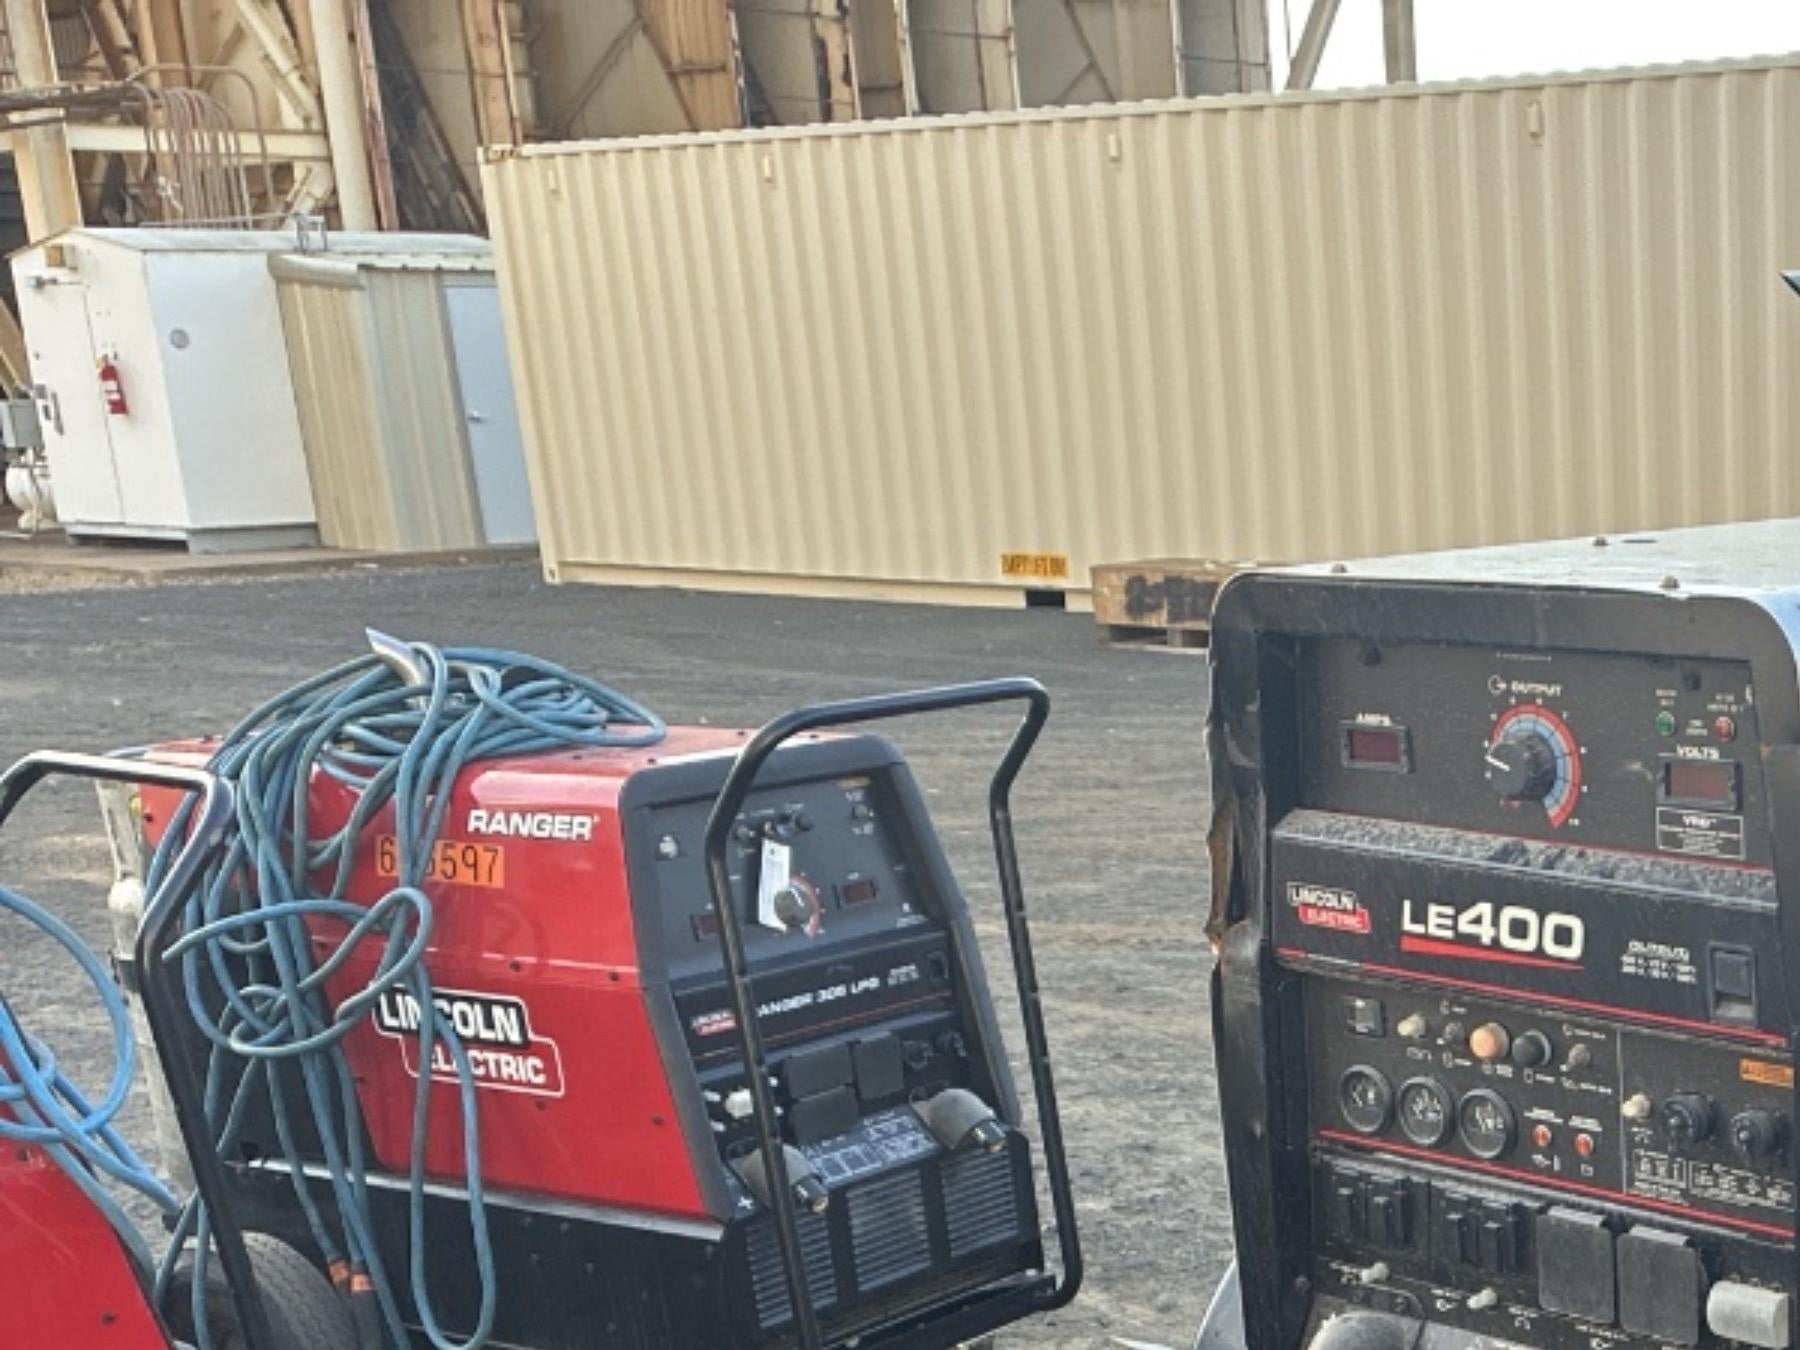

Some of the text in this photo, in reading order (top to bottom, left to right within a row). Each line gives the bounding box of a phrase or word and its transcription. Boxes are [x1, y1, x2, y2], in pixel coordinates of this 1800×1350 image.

[1675, 744, 1721, 761] VOLTS
[467, 808, 593, 840] RANGER
[377, 835, 500, 884] 6597
[1402, 899, 1584, 960] LE400
[379, 991, 523, 1045] LINOLN
[430, 1043, 547, 1084] LCTRIC
